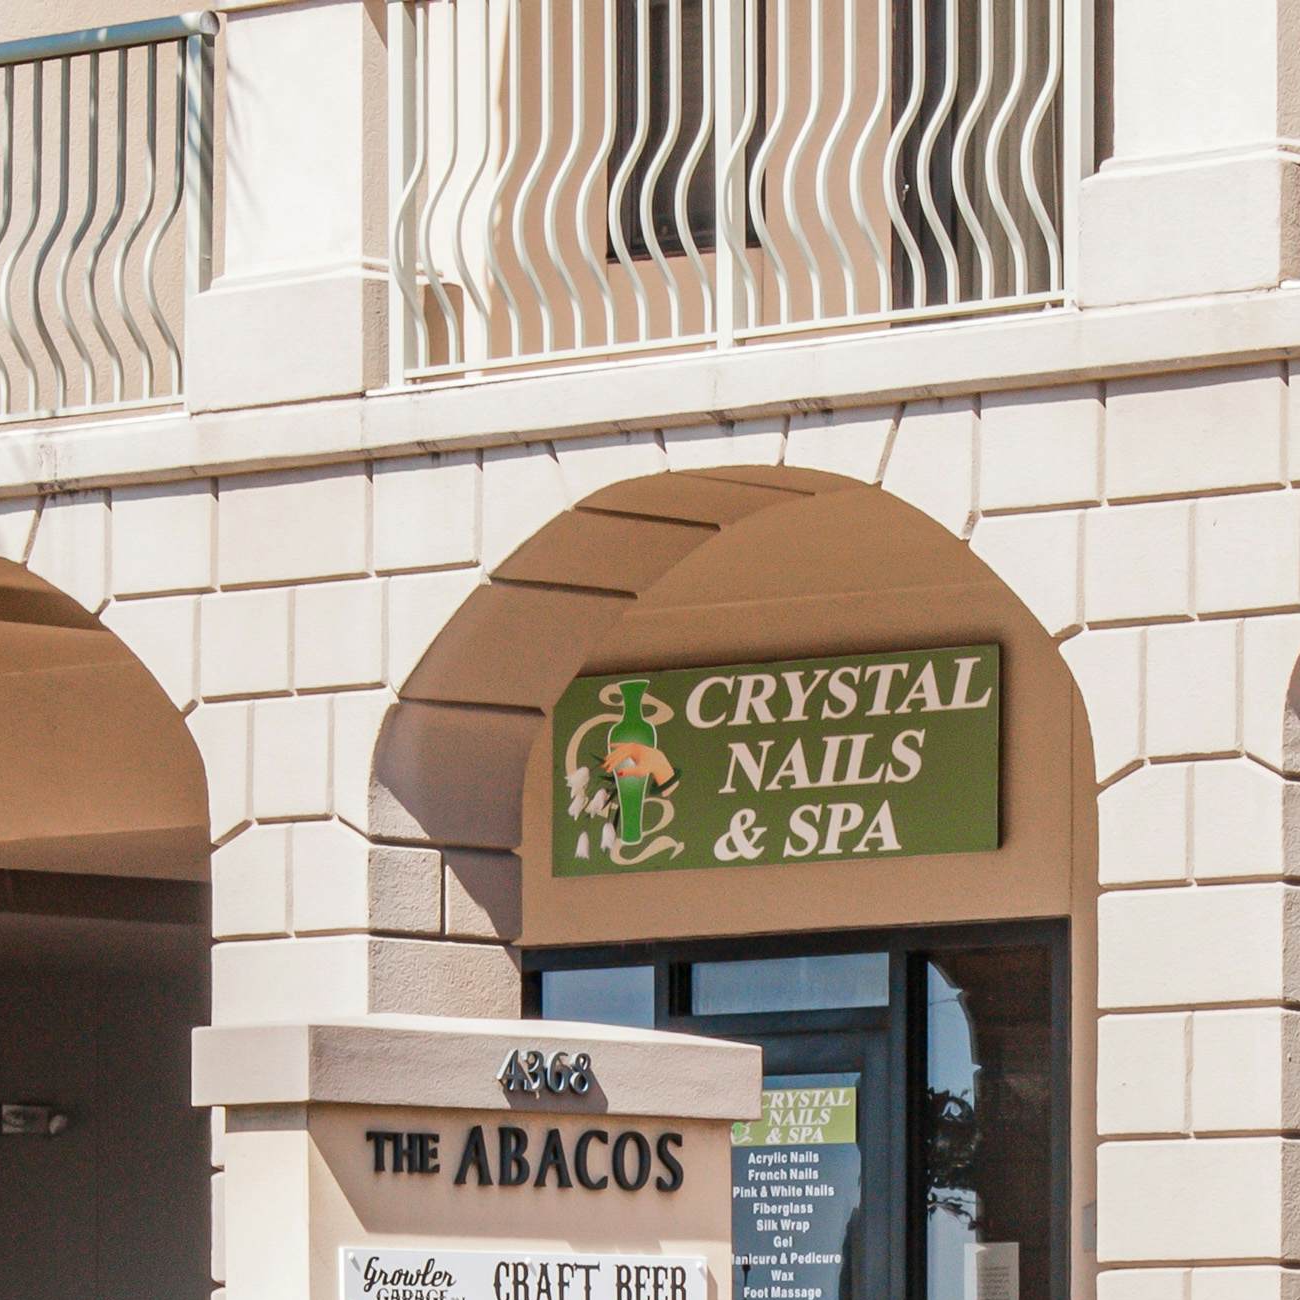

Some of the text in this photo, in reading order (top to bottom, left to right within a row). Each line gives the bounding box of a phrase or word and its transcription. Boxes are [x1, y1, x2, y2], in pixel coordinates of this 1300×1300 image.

[685, 657, 992, 728] CRYSTAL
[718, 729, 926, 794] NAILS
[713, 800, 902, 861] & SPA
[496, 1048, 592, 1095] 4368
[769, 1108, 831, 1126] NAILS
[765, 1127, 824, 1144] & SPA
[366, 1125, 684, 1192] THE ABACOS
[748, 1151, 819, 1166] Acrylic Nails
[748, 1168, 819, 1181] French Nails
[733, 1185, 835, 1198] Pink & White Nails
[753, 1203, 813, 1216] Fiberglass
[756, 1219, 810, 1233] Silk Wrap
[773, 1236, 793, 1248] Gel
[732, 1252, 841, 1265] anicure & Pedicure
[363, 1256, 457, 1292] Growler
[771, 1270, 794, 1281] Wax
[744, 1287, 822, 1300] Foot Massage
